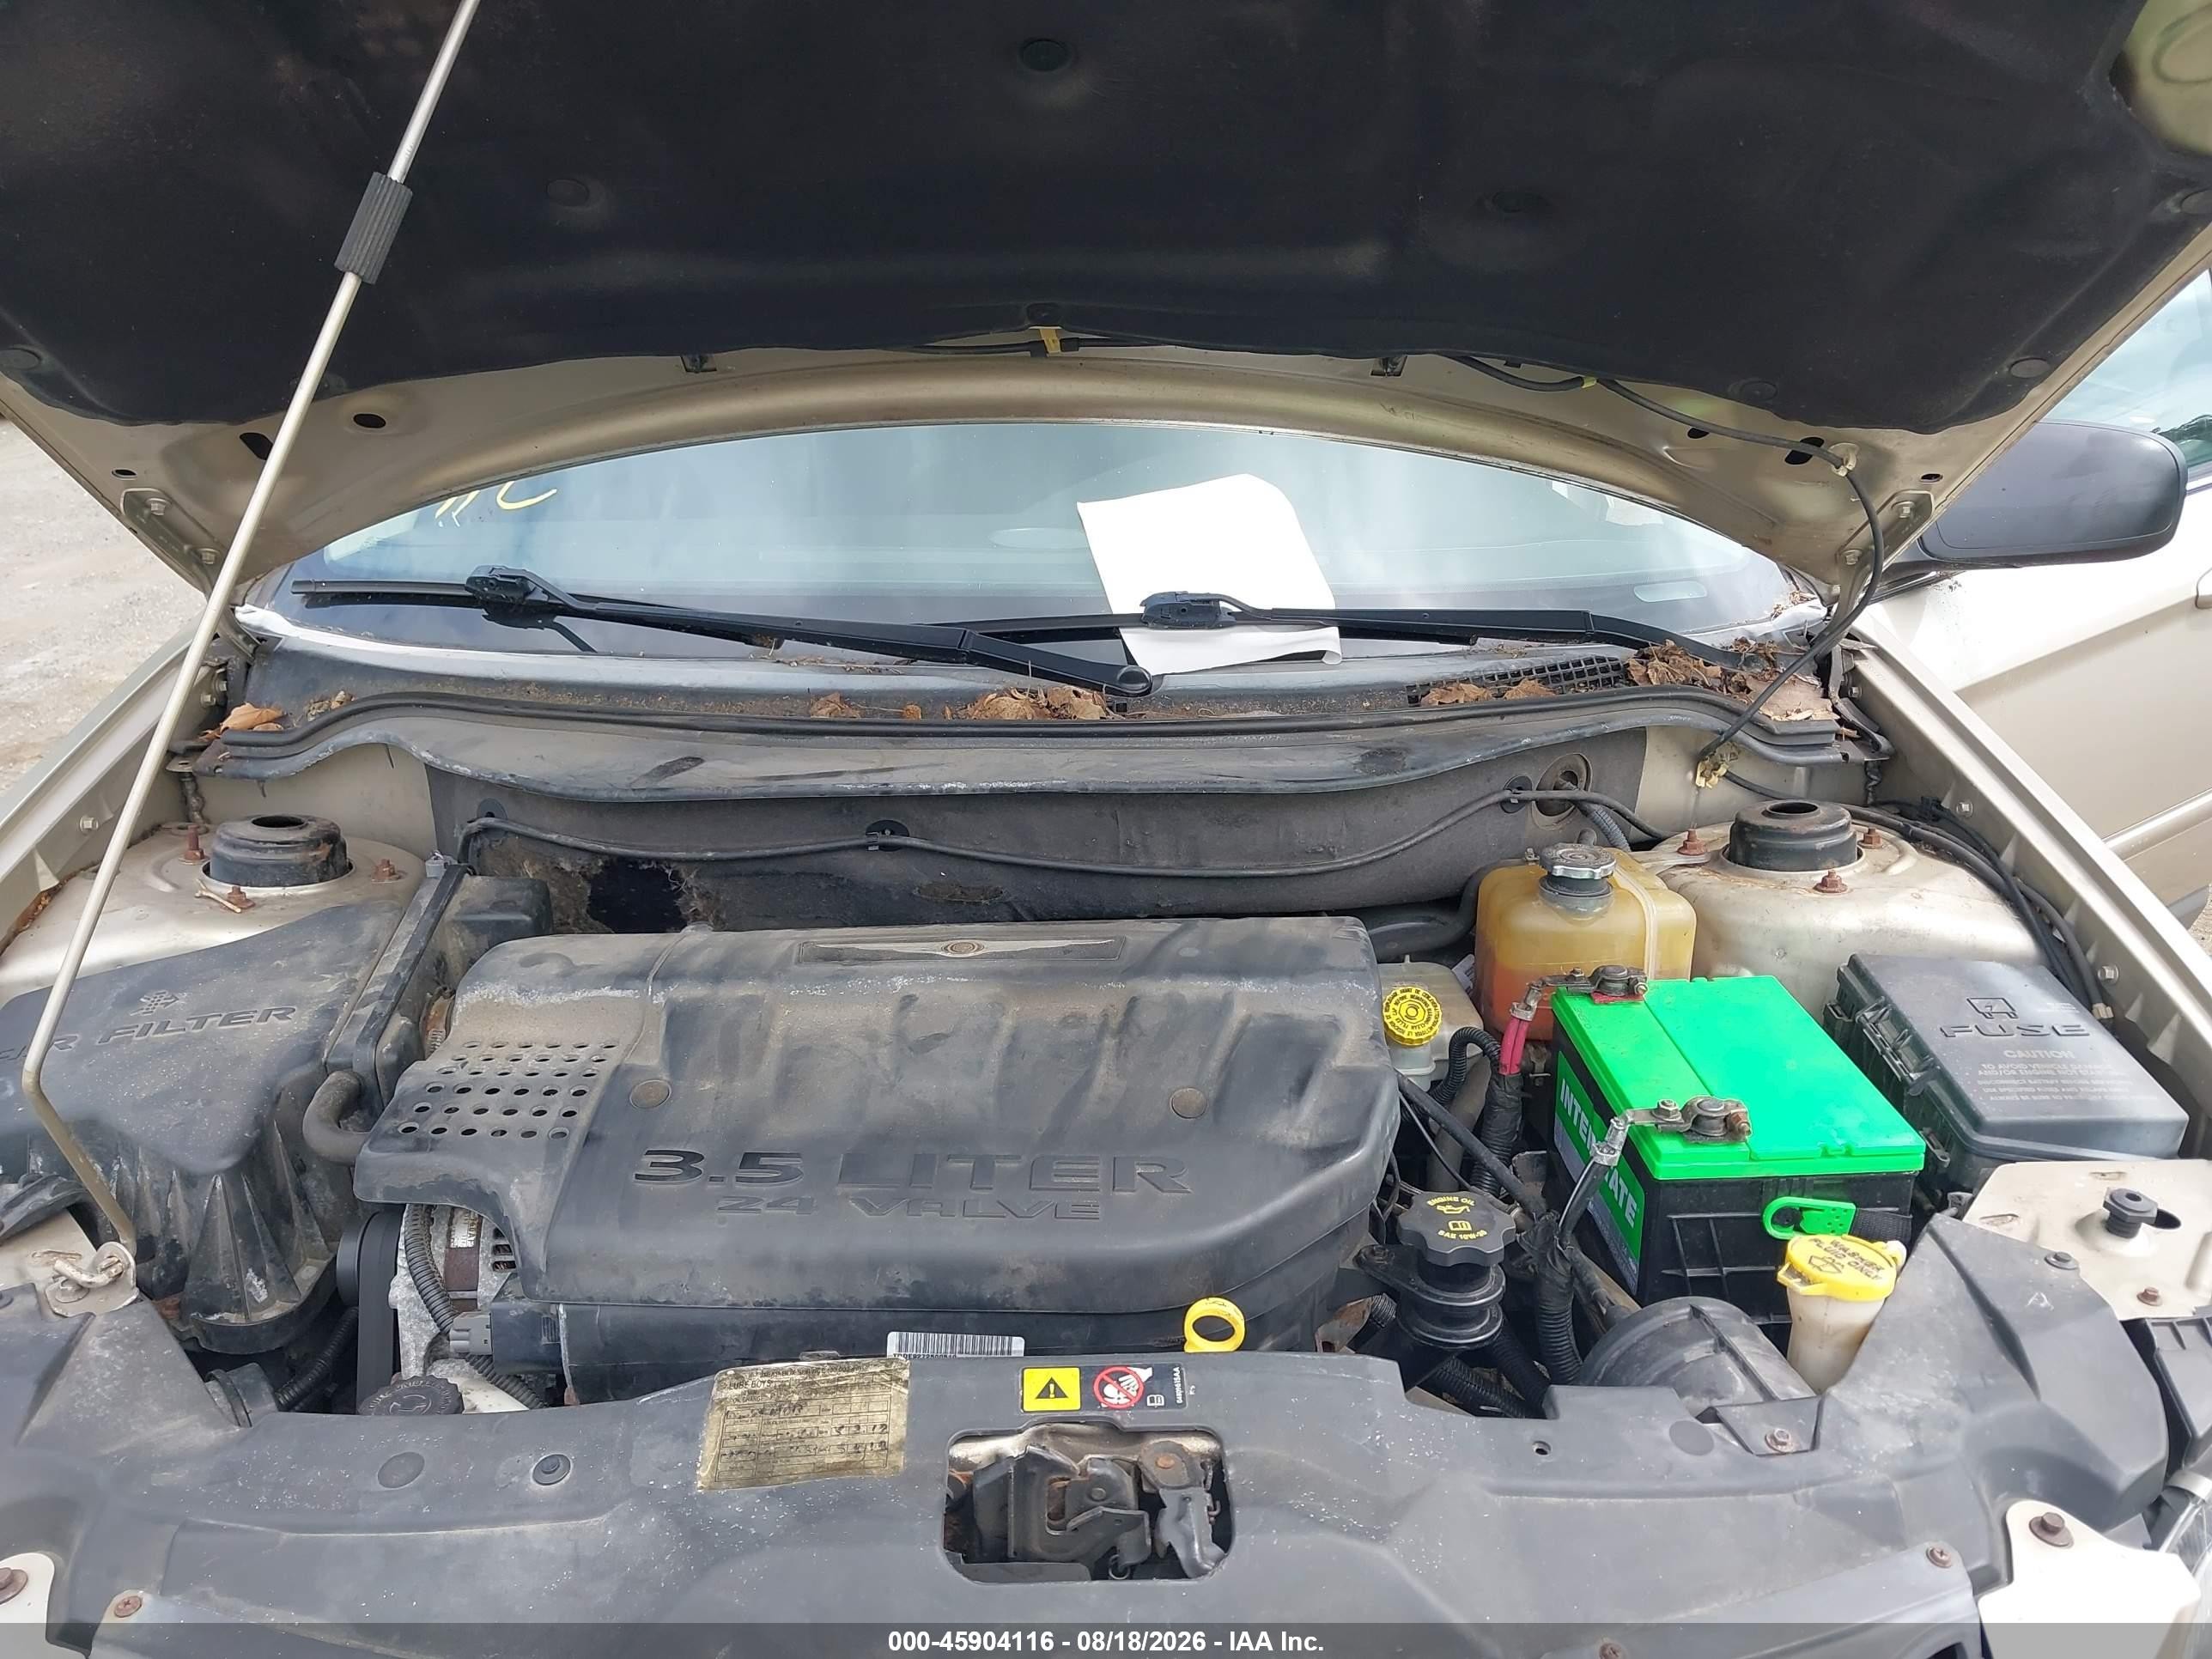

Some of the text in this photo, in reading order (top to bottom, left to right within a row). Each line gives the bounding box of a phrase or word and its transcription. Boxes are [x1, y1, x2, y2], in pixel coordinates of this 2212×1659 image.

[97, 1006, 296, 1044] FILTER
[1940, 1024, 2090, 1037] FUSE
[2002, 1049, 2075, 1059] CAUTION
[634, 1150, 1192, 1194] 3.5 LITER
[716, 1195, 1100, 1220] 24 VALVE
[1426, 1196, 1475, 1206] ENGINE OIL
[1437, 1230, 1457, 1239] SAE
[1809, 1238, 1882, 1279] FLUID ONLY
[1831, 1240, 1885, 1271] WASHER
[729, 1381, 749, 1389] LUBE
